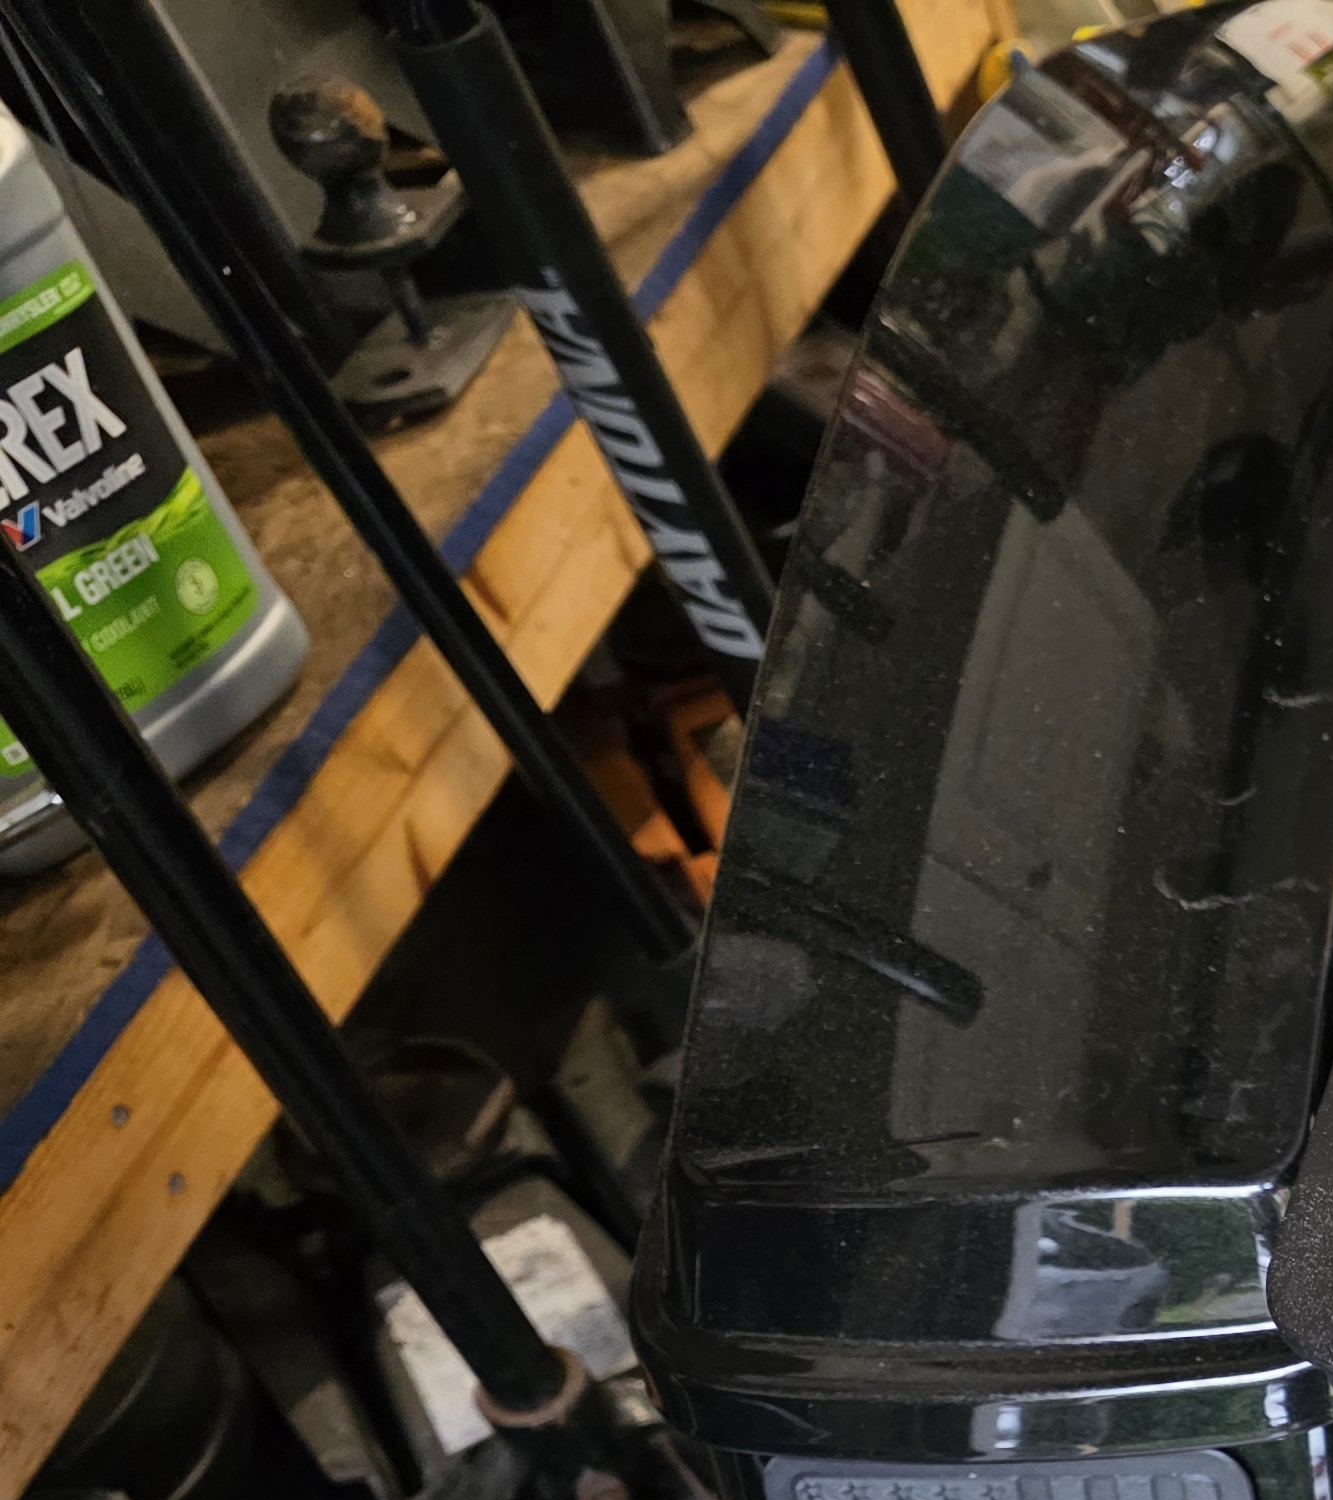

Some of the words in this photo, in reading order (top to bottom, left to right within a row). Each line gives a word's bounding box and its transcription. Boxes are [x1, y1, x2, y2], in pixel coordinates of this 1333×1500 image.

[0, 346, 128, 510] REX
[513, 283, 766, 661] DAYTONA
[42, 453, 147, 527] Valvoline
[74, 532, 160, 606] GREEN
